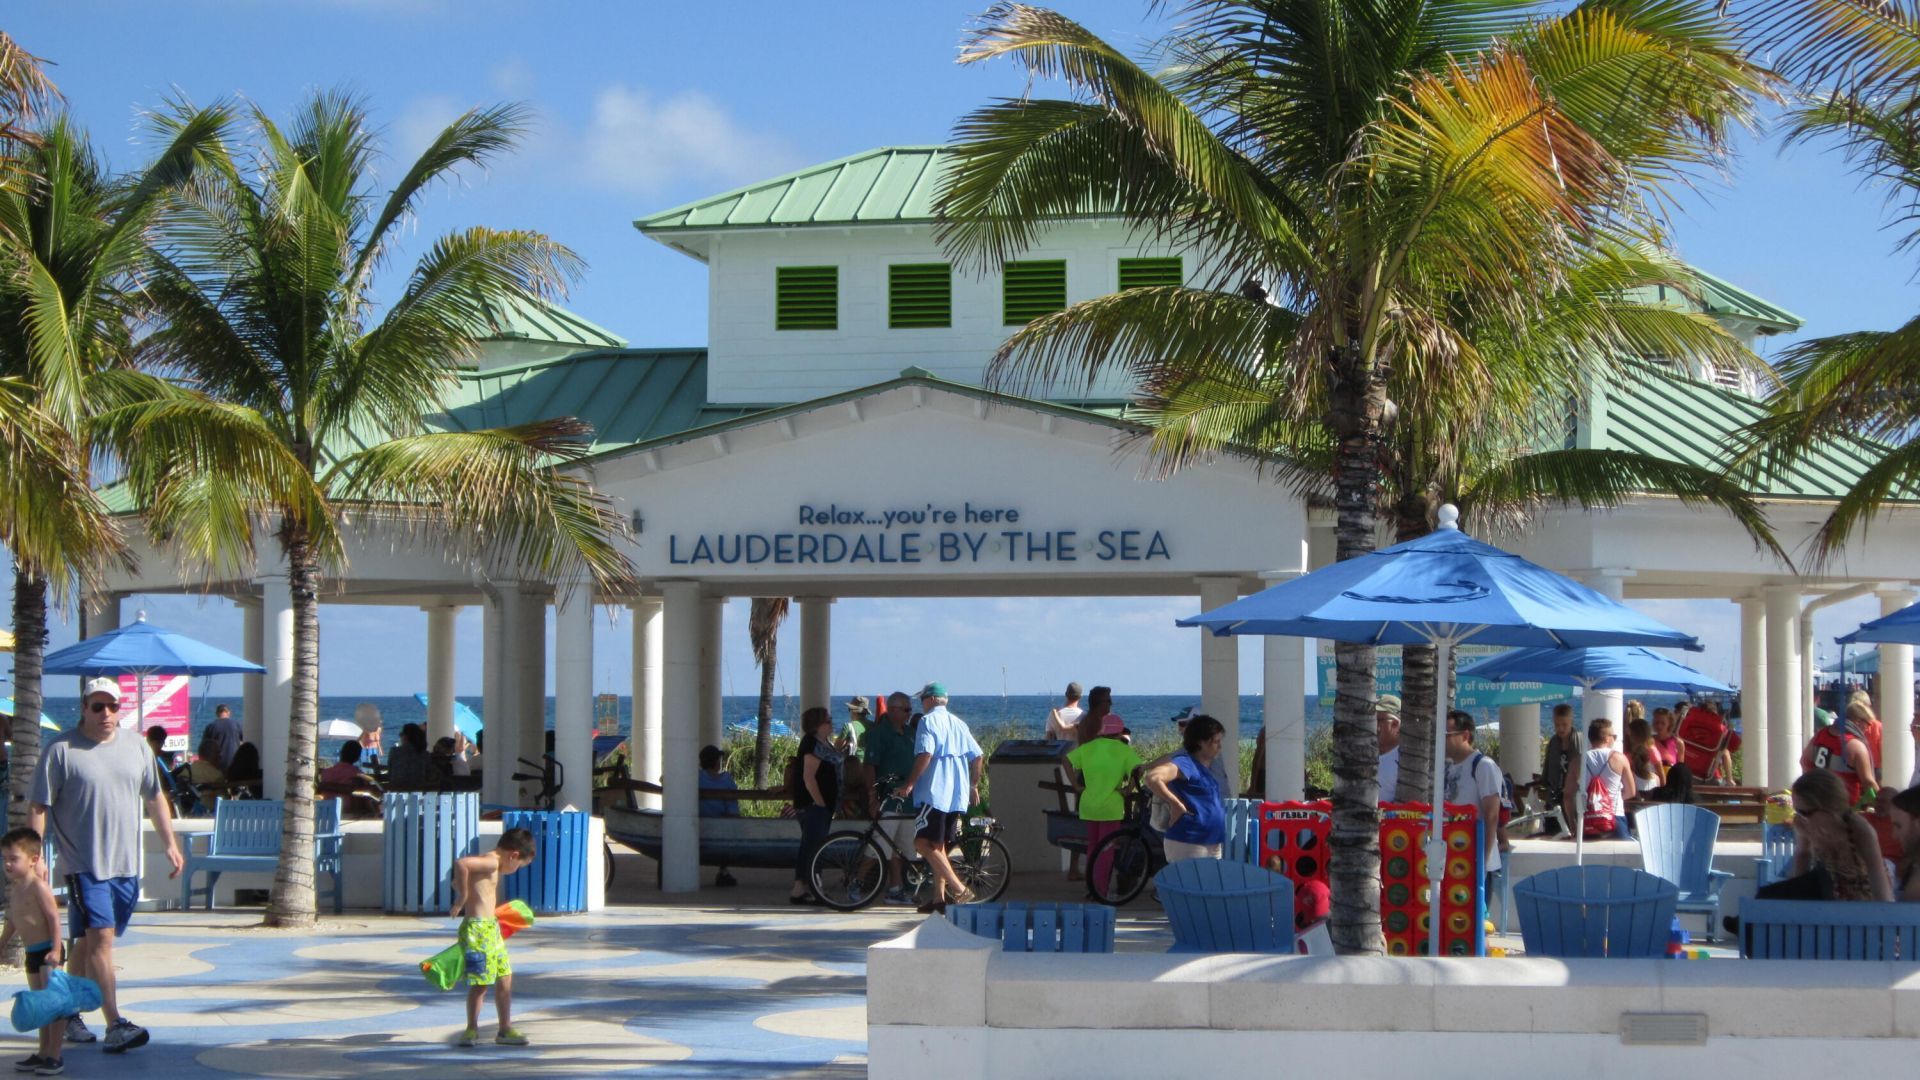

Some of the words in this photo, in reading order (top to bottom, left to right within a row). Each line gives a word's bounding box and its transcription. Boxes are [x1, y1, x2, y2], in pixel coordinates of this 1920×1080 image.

[964, 502, 1020, 524] here
[669, 533, 921, 565] LAUDERDALE
[939, 532, 987, 563] BY
[1001, 531, 1077, 562] THE
[1096, 530, 1171, 561] SEA
[1464, 680, 1477, 690] of
[1478, 682, 1506, 693] every
[1509, 681, 1543, 690] month
[1460, 697, 1476, 707] pm
[169, 738, 186, 748] BLVD
[1814, 746, 1829, 769] 6
